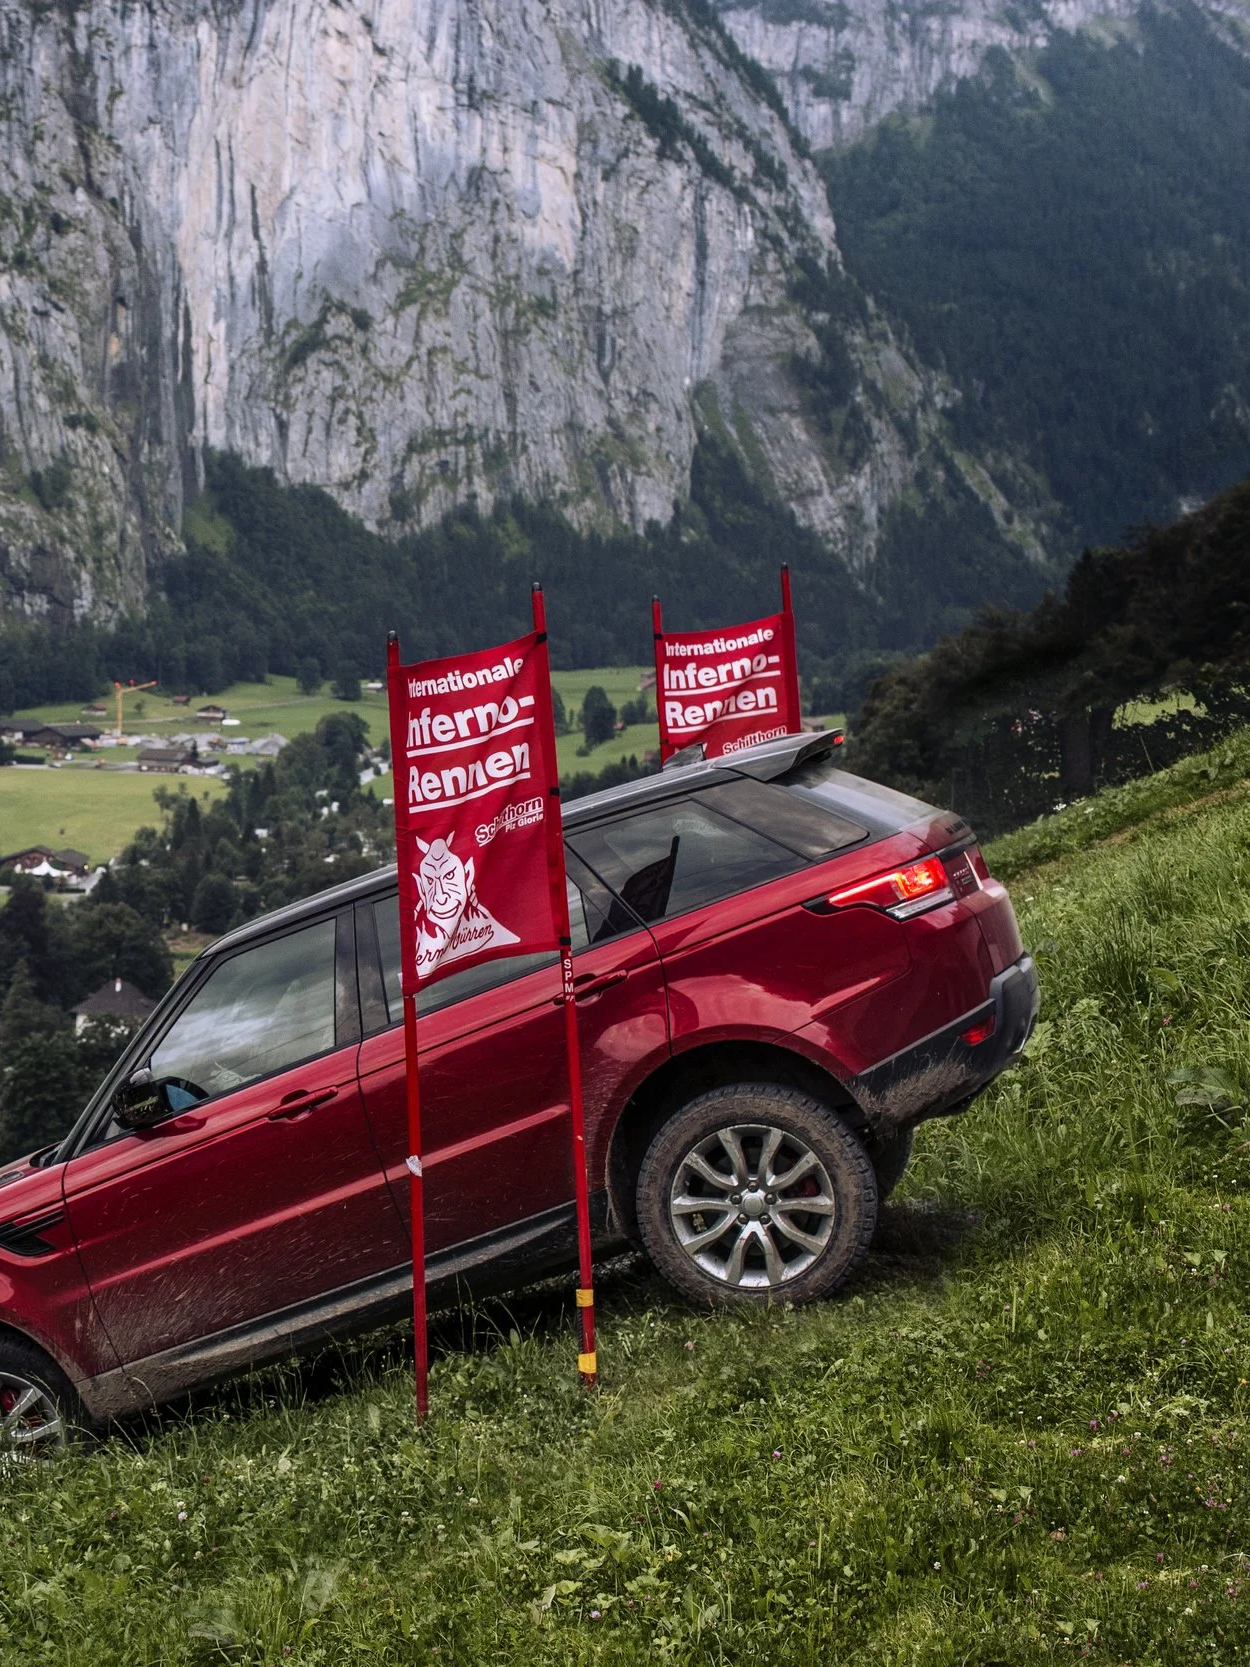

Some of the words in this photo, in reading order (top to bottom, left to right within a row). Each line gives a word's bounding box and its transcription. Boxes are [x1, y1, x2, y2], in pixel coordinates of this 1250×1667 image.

[665, 628, 774, 657] Internationale
[408, 656, 523, 698] nternationale
[663, 653, 780, 689] Inferno-
[665, 686, 777, 727] Rennen
[722, 725, 787, 755] Schilthorn
[408, 742, 530, 803] Rennen
[474, 796, 544, 844] Schthorn
